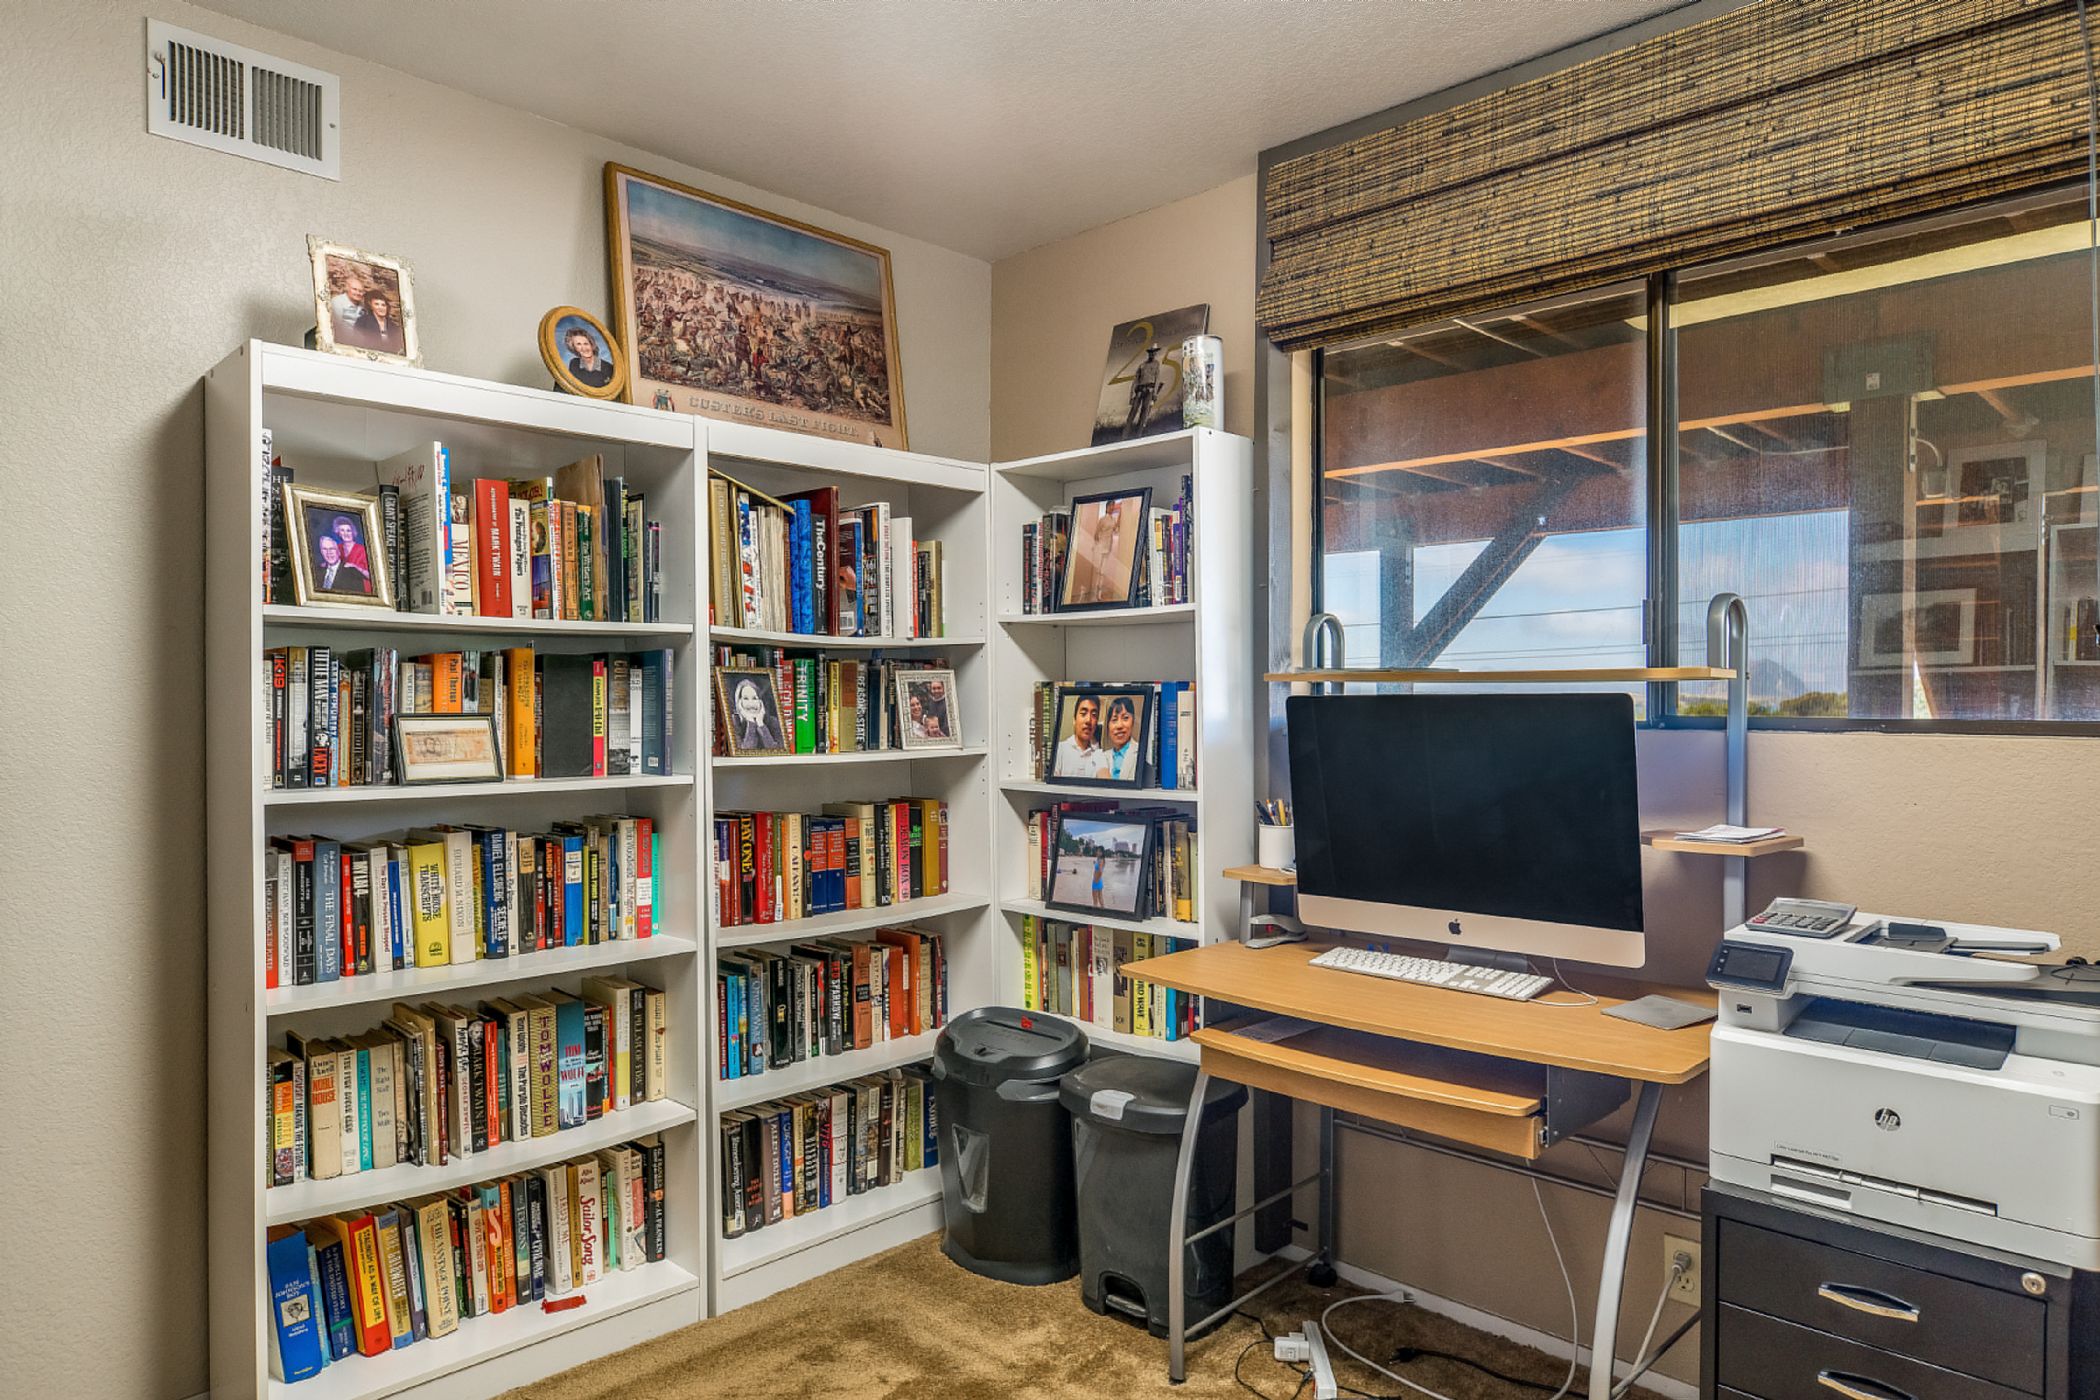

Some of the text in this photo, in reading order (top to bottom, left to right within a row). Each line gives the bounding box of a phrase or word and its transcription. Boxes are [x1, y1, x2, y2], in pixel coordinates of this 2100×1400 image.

[689, 396, 808, 427] CUSTER'S LAST
[384, 496, 396, 520] GRANT
[386, 521, 397, 548] SPEAKS
[514, 507, 524, 576] The Pentagon Papers
[452, 540, 470, 590] MEXICO
[490, 528, 502, 576] MARK TWAIN
[584, 587, 592, 602] Art
[314, 650, 330, 678] LITTLE
[314, 678, 329, 700] MAN
[450, 658, 458, 703] Paul Theroux
[796, 666, 808, 722] TRINITY
[856, 676, 866, 742] REASONS STATE
[312, 748, 327, 774] LACEY
[626, 826, 634, 840] Bob
[741, 818, 752, 873] DAY ONE
[453, 848, 464, 888] RICHARD
[626, 842, 636, 878] Woodward
[900, 825, 910, 884] DEMON BOX
[352, 860, 369, 898] MY LAI 4
[380, 877, 388, 889] Day
[420, 864, 432, 922] TRANSCRIPTS
[430, 863, 442, 920] WHITE HOUSE
[492, 834, 508, 942] DANIEL ELLSBERG SECRETS
[626, 882, 636, 895] The
[282, 866, 291, 967] SECRET BOB WOODWARD
[456, 900, 465, 928] NIXON
[324, 890, 336, 974] THE FINAL DAYS
[382, 927, 392, 952] Stopped
[831, 960, 842, 1020] RED SPARROW
[752, 980, 762, 1042] OPIUM WARS
[1137, 998, 1145, 1019] WAVE
[565, 1043, 581, 1057] TOM
[634, 1014, 644, 1086] PILLAR OF FIRE
[312, 1076, 335, 1091] NOBLE
[473, 1047, 484, 1118] MARK TWAIN
[516, 1016, 528, 1136] Tom Wolfe The Purple Decades
[539, 1016, 552, 1127] TOM WOLFE
[560, 1066, 584, 1081] WOLFE
[312, 1089, 337, 1105] HOUSE
[461, 1076, 470, 1104] GEORGE
[294, 1102, 304, 1128] MAKING
[928, 1096, 938, 1140] EXODUS
[1876, 1108, 1900, 1130] hp
[295, 1130, 304, 1142] THE
[820, 1122, 830, 1148] 1776
[295, 1144, 304, 1168] FUTURE
[730, 1136, 741, 1188] Remembering
[624, 1178, 632, 1198] HOT
[656, 1208, 662, 1218] AL
[436, 1224, 446, 1240] THE
[580, 1196, 597, 1265] Sailor Song
[365, 1228, 374, 1263] STALINISM
[368, 1264, 376, 1274] AS
[388, 1252, 406, 1299] GOLDWATER
[440, 1242, 450, 1282] VANTAGE
[370, 1282, 378, 1294] WAY
[372, 1295, 380, 1305] OF
[374, 1306, 382, 1320] LIFE
